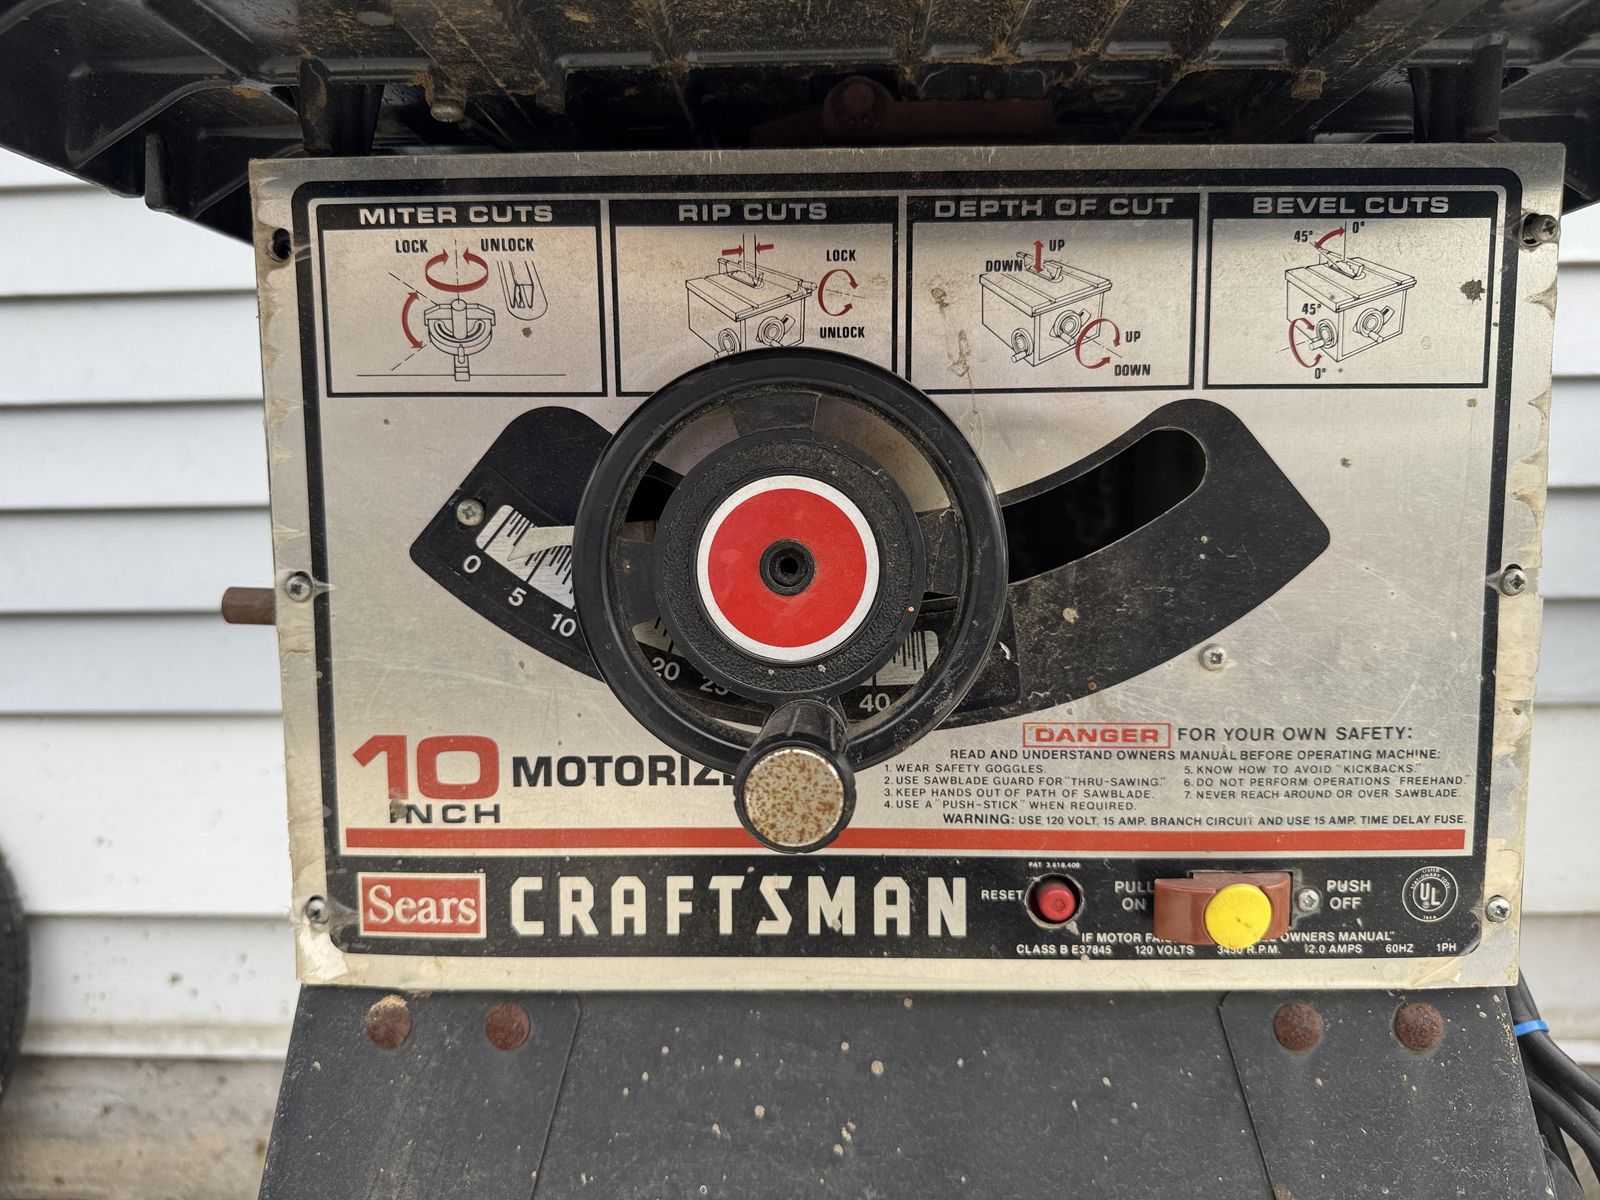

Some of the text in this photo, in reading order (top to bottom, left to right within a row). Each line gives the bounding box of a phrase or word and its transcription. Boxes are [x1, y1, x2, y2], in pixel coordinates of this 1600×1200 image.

[934, 197, 1173, 219] DEPTH OF CUT
[1252, 196, 1449, 214] BEVEL CUTS
[359, 205, 554, 226] MITER CUTS
[678, 203, 828, 222] RIP CUTS
[395, 240, 428, 254] LOCK
[480, 238, 534, 252] UNLOCK
[1048, 238, 1065, 252] UP
[826, 249, 856, 262] LOCK
[985, 259, 1022, 273] DOWN
[819, 326, 865, 340] UNLOCK
[1125, 331, 1141, 343] UP
[1114, 364, 1151, 376] DOWN
[463, 554, 482, 574] 0
[507, 586, 527, 607] 5
[550, 612, 577, 638] 10
[652, 657, 680, 680] 20
[859, 693, 890, 712] 40
[1035, 728, 1159, 742] DANGER
[1178, 726, 1412, 741] FOR YOUR OWN SAFETY:
[950, 749, 1440, 760] READ AND UNDERSTAND OWNERS MANUAL BEFORE OPERATING MACHINE:
[352, 734, 500, 800] 10
[512, 755, 736, 788] MOTORIZ
[896, 764, 930, 773] WEAR
[935, 764, 980, 773] SAFETY
[985, 764, 1046, 774] GOGGLES.
[1197, 766, 1232, 774] KNOW
[1238, 766, 1266, 774] HOW
[1272, 766, 1288, 774] TO
[1294, 765, 1332, 774] AVOID
[896, 776, 918, 785] USE
[924, 776, 988, 785] SAWBLADE
[993, 777, 1034, 785] GUARD
[1039, 777, 1062, 786] FOR
[1197, 778, 1214, 786] DO
[1220, 778, 1244, 786] NOT
[1251, 777, 1308, 786] PERFORM
[1314, 777, 1390, 785] OPERATIONS
[896, 788, 926, 797] KEEP
[932, 788, 972, 797] HANDS
[976, 789, 1000, 797] OUT
[1004, 789, 1020, 797] OF
[1026, 789, 1056, 798] PATH
[1062, 789, 1078, 798] OF
[1083, 790, 1154, 798] SAWBLADE.
[1197, 790, 1236, 799] NEVER
[1241, 790, 1278, 799] REACH
[1284, 790, 1332, 799] AROUND
[1336, 790, 1352, 798] OR
[1358, 790, 1389, 798] OVER
[1395, 789, 1461, 798] SAWBLADE.
[896, 800, 919, 808] USE
[925, 800, 932, 808] A
[1029, 801, 1064, 810] WHEN
[1070, 802, 1137, 810] REQUIRED.
[390, 804, 500, 824] INCH
[943, 814, 1014, 824] WARNING:
[1018, 816, 1041, 824] USE
[1046, 816, 1064, 825] 120
[1103, 816, 1114, 825] 15
[1118, 816, 1146, 825] AMP.
[1151, 817, 1201, 826] BRANCH
[1206, 817, 1254, 825] CIRCUIT
[1258, 816, 1283, 825] AND
[1287, 816, 1309, 825] USE
[1314, 816, 1325, 824] 15
[1360, 816, 1388, 824] TIME
[1392, 815, 1430, 824] DELAY
[1434, 815, 1467, 824] FUSE.
[1114, 880, 1154, 893] PULL
[1326, 880, 1371, 892] PUSH
[981, 890, 1024, 900] RESET
[367, 885, 478, 926] Sears
[510, 875, 968, 938] CRAFTSMAN
[1122, 897, 1145, 910] ON
[1329, 897, 1361, 910] OFF
[1081, 932, 1093, 942] IF
[1096, 932, 1140, 942] MOTOR
[1280, 932, 1335, 942] OWNERS
[1016, 944, 1056, 954] CLASS
[1060, 945, 1068, 954] B
[1071, 945, 1112, 954] E37845
[1134, 945, 1154, 954] 120
[1156, 945, 1194, 954] VOLTS
[1246, 945, 1280, 954] R.P.M.
[1328, 944, 1362, 953] AMPS
[1386, 943, 1414, 953] 60HZ
[1436, 942, 1457, 952] 1PH
